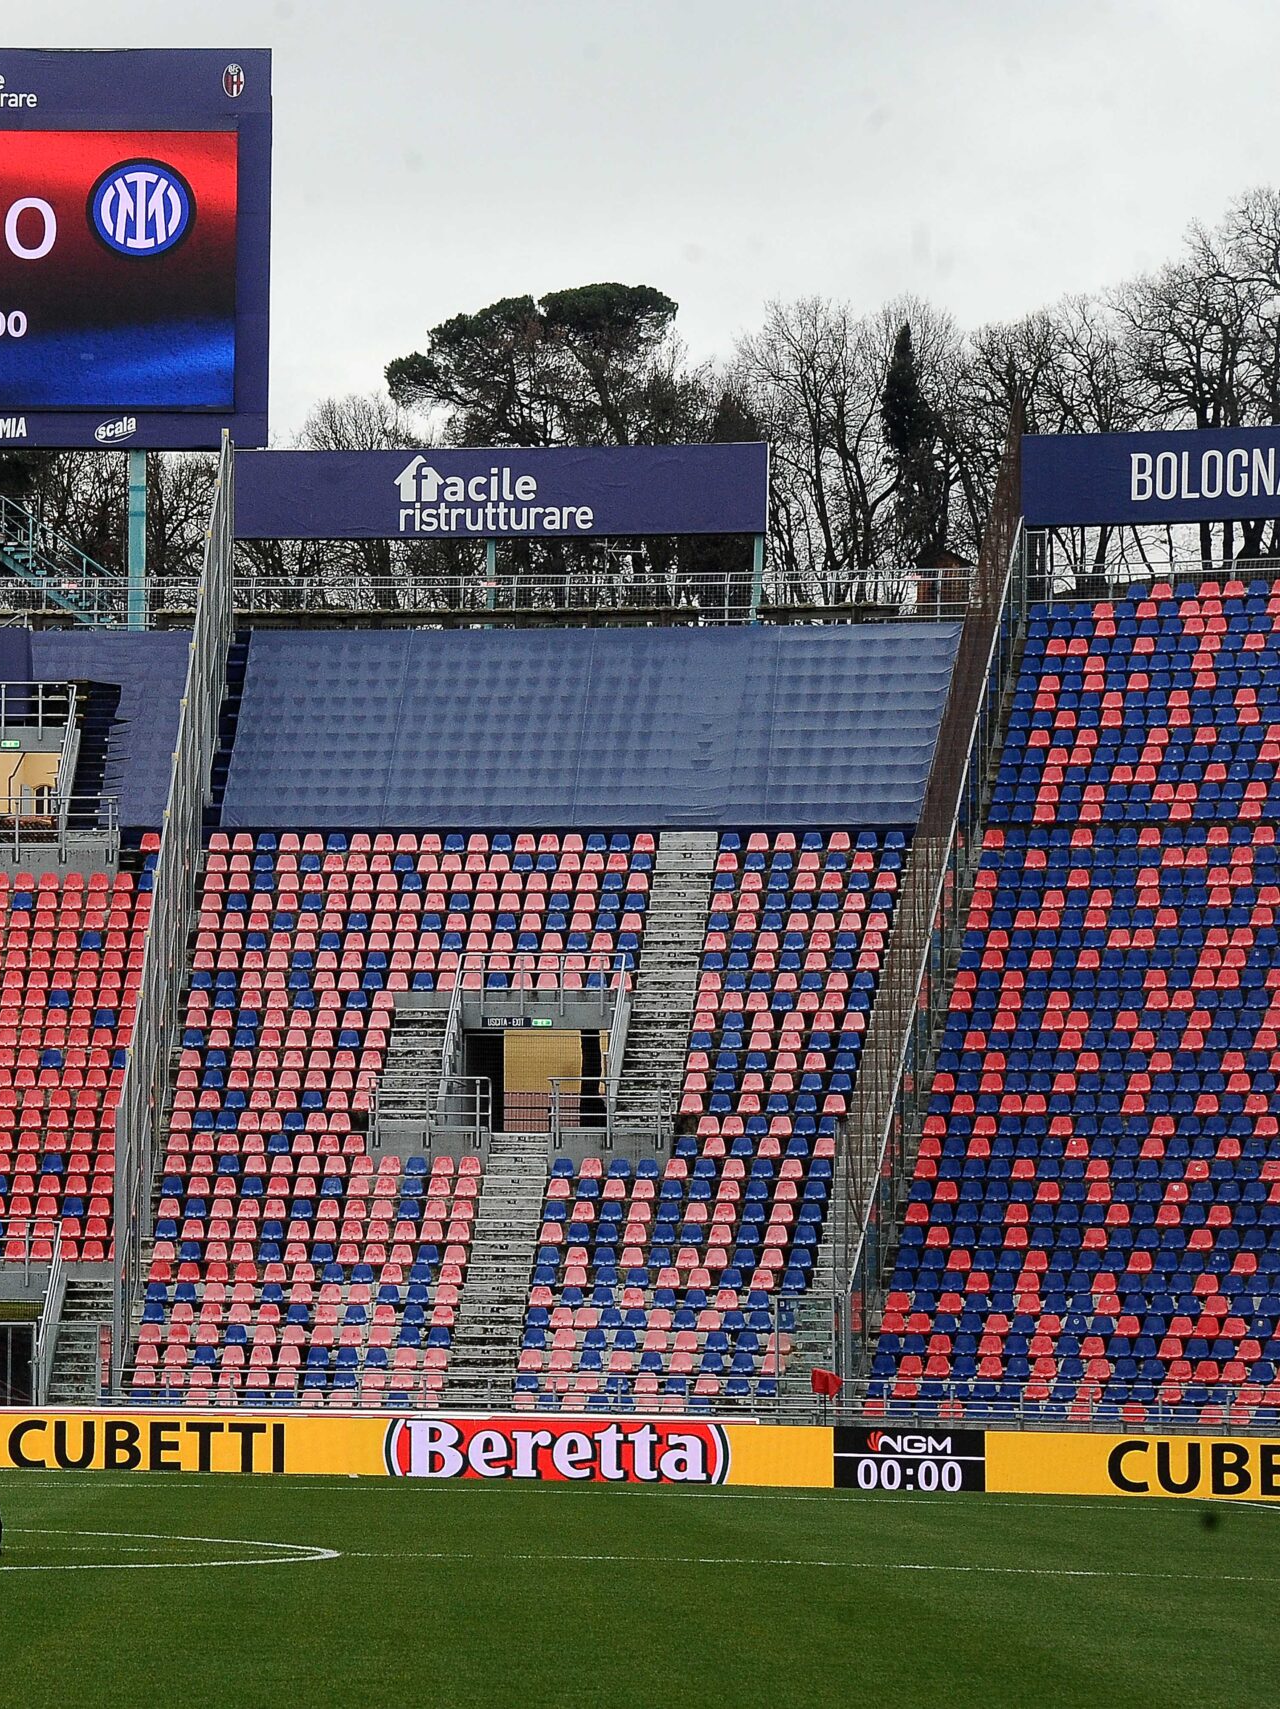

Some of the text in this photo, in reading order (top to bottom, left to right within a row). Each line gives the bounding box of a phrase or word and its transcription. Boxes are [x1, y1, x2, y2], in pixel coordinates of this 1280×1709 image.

[96, 416, 137, 440] scala
[395, 455, 537, 502] facile
[1130, 447, 1280, 501] BOLOGN
[399, 501, 594, 532] ristrutturare
[8, 1419, 286, 1473] CUBETTI
[402, 1418, 708, 1483] Beretta
[877, 1435, 952, 1454] NGM
[857, 1458, 963, 1492] 00:00
